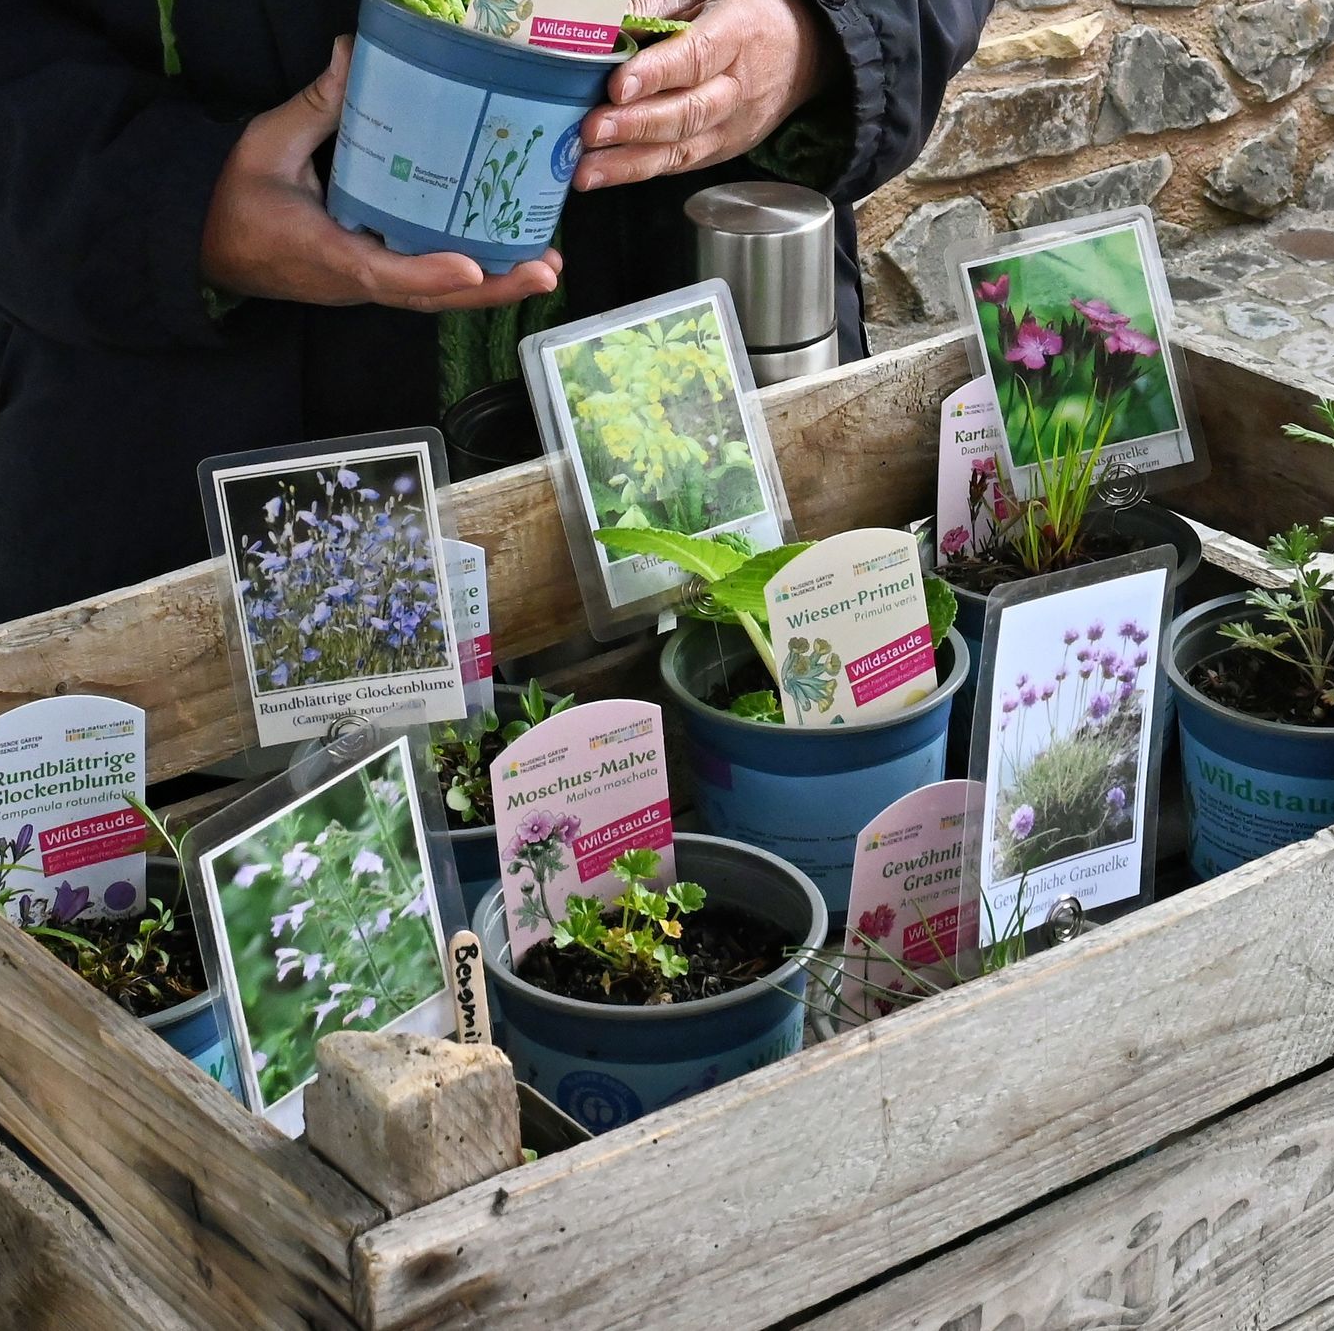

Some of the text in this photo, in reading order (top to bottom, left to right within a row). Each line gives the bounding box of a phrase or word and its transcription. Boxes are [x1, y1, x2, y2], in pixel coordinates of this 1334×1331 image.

[537, 21, 608, 40] Wildstaude
[787, 573, 915, 629] Wiesen-Primel
[854, 594, 917, 622] Primula veris
[851, 635, 923, 677] Wildstaude
[259, 680, 455, 716] Rundblättrige Glockenblume
[507, 749, 657, 810] Moschus-Malve
[566, 768, 658, 804] Malva moschata
[45, 814, 135, 846] Wildstaude
[579, 808, 660, 852] Wildstaude
[993, 854, 1129, 910] Gewhnliche Grasnelke
